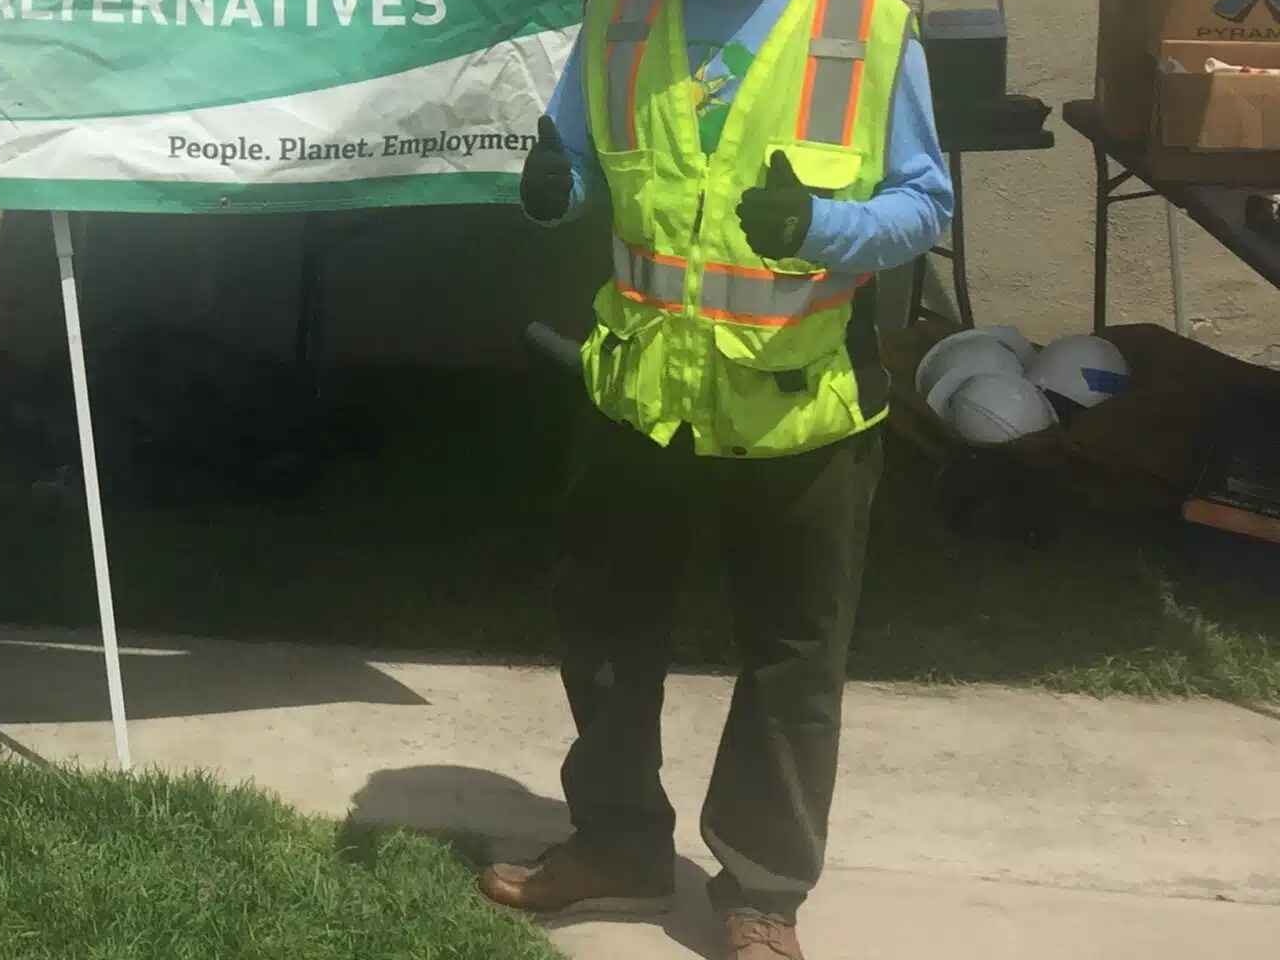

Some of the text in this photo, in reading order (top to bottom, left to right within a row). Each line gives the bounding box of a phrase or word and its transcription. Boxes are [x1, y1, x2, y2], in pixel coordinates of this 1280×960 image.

[168, 130, 537, 166] People. Planet. Employmen
